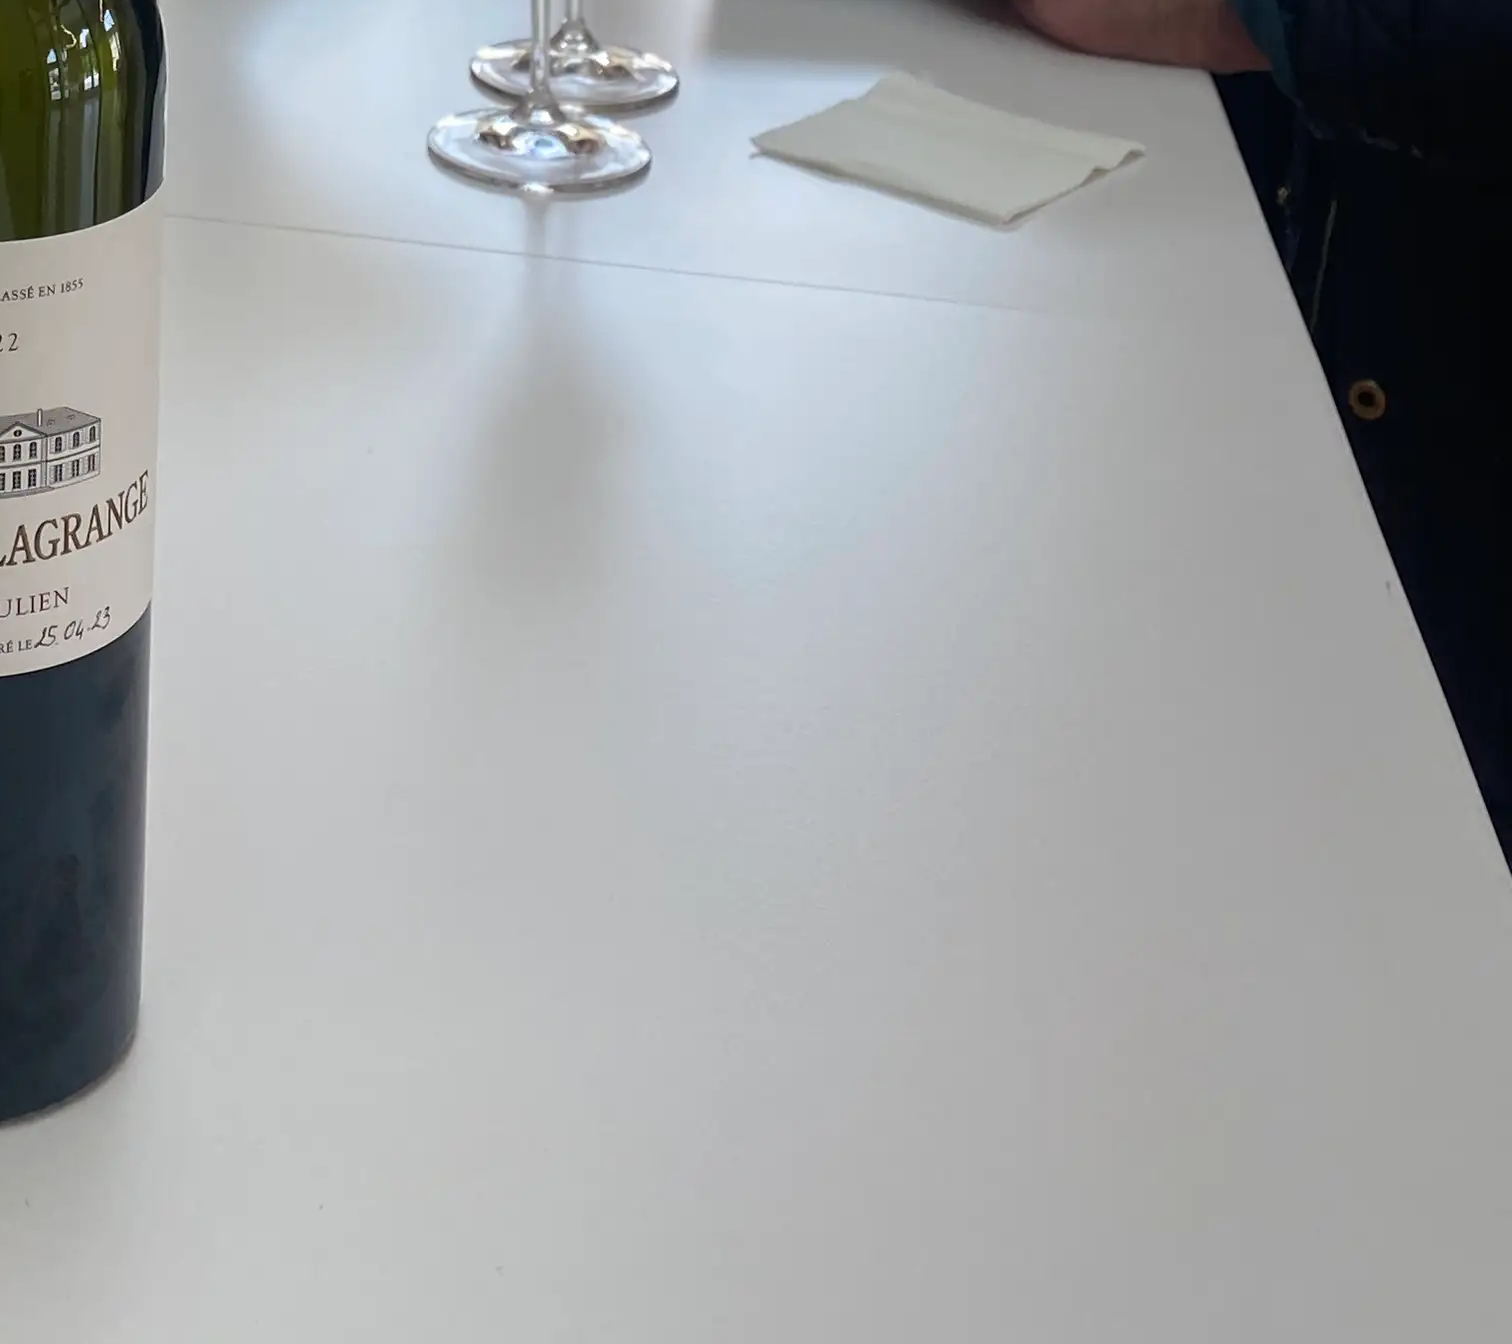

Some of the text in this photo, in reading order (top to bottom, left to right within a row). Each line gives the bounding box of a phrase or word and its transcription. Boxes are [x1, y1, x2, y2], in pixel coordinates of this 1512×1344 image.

[38, 284, 56, 298] EN
[60, 277, 84, 294] 1855
[17, 639, 33, 652] LE
